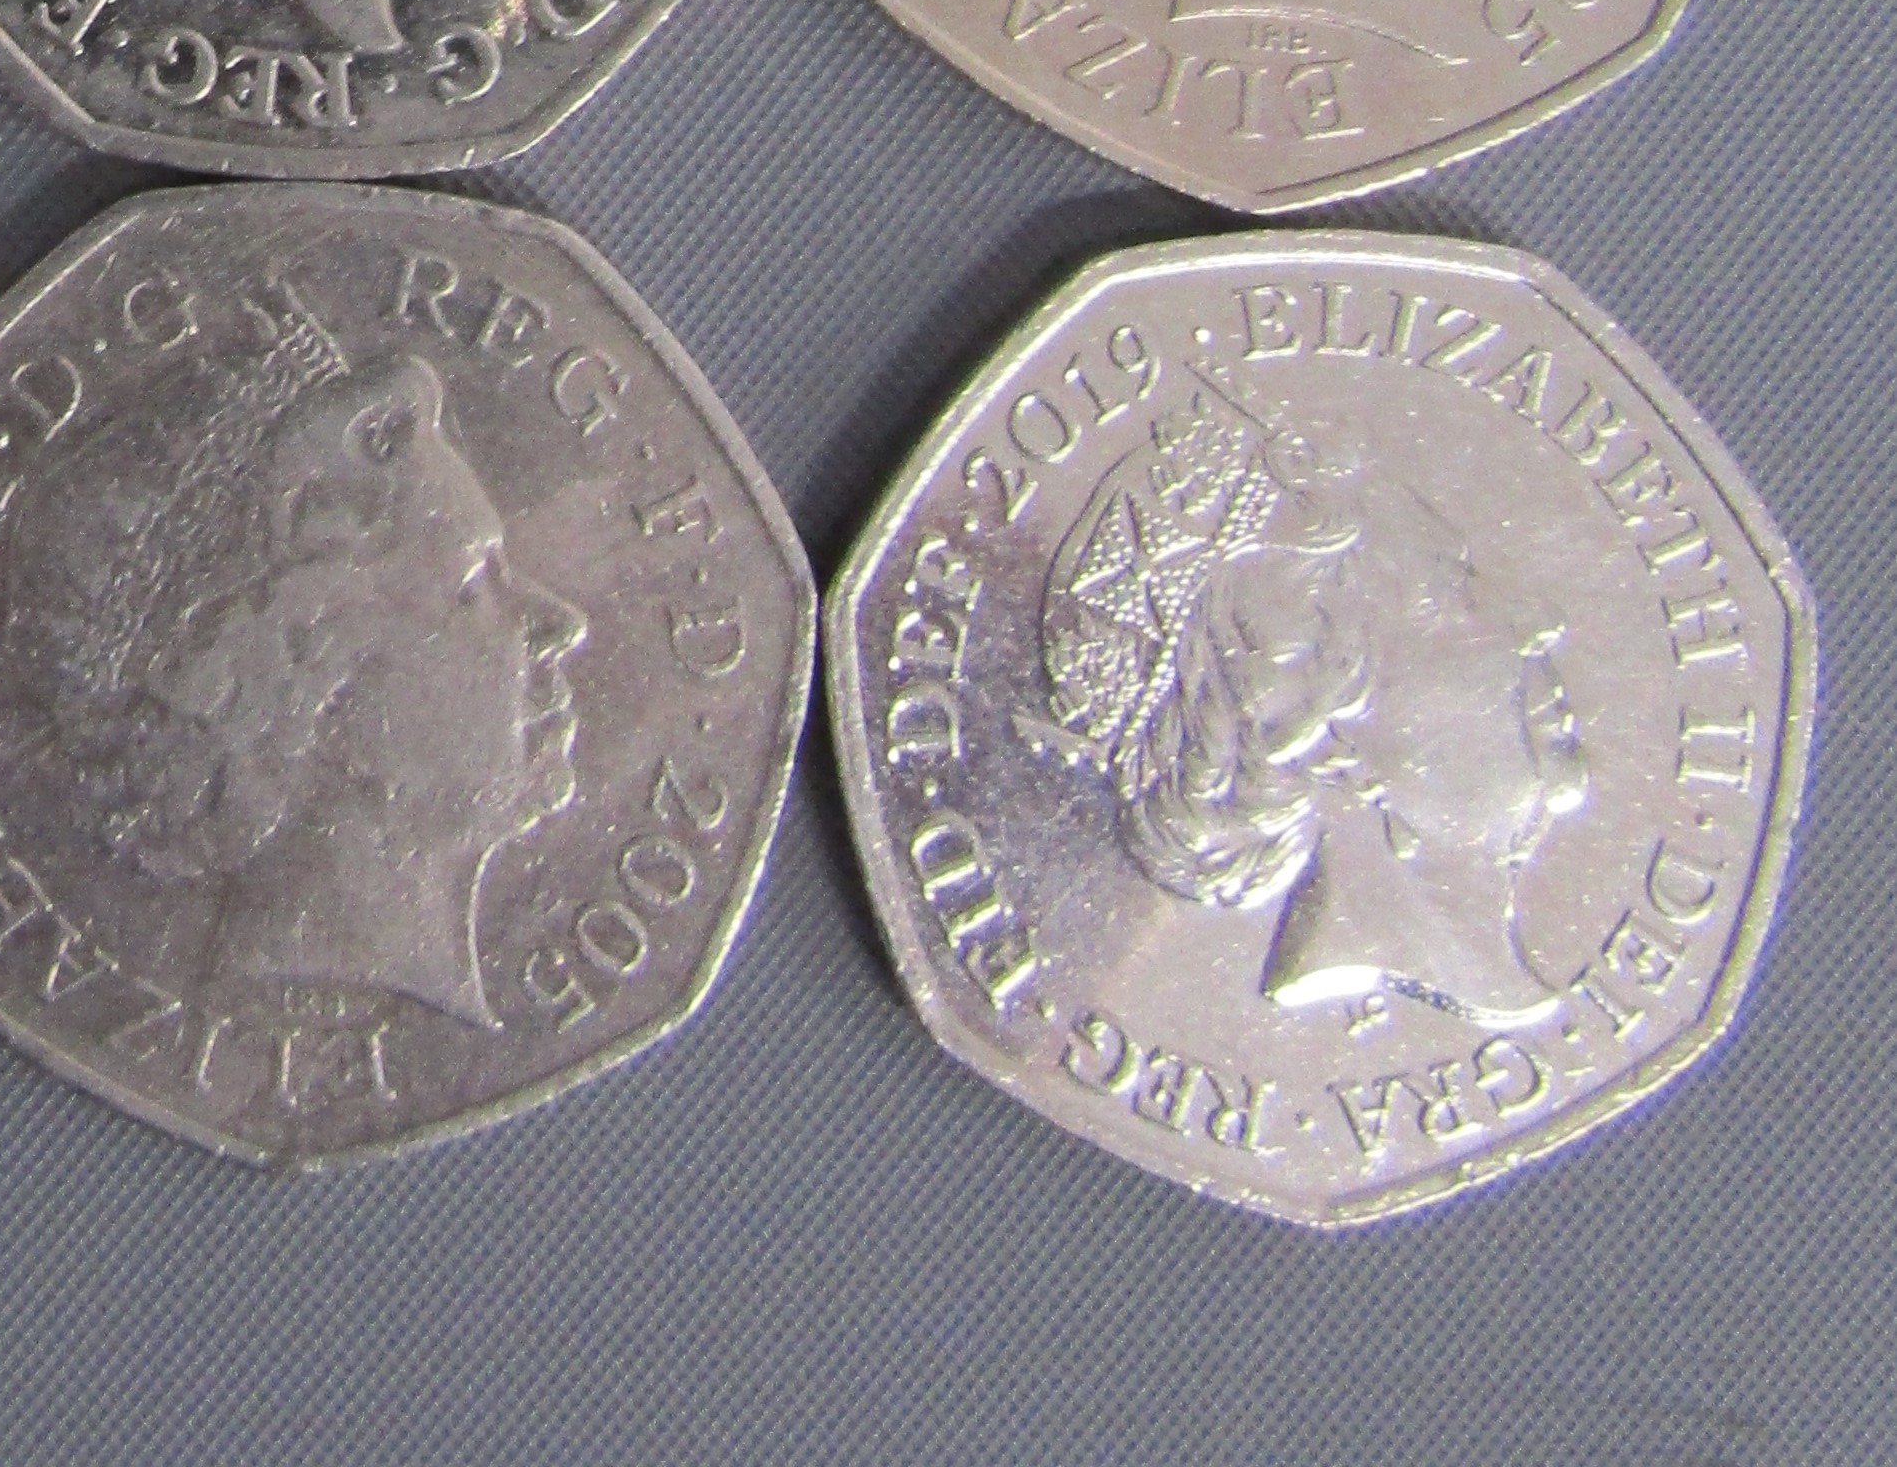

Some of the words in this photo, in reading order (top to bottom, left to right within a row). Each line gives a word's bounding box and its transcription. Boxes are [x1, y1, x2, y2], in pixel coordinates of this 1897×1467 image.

[143, 25, 360, 130] REG
[430, 21, 505, 106] G
[121, 265, 200, 351] G
[384, 254, 635, 439] REG
[8, 351, 85, 443] D
[963, 323, 1165, 525] 2019
[629, 473, 724, 546] F
[1230, 279, 1748, 668] ELIZABETH
[667, 601, 748, 678] D
[885, 533, 985, 767] DEF
[1676, 703, 1759, 794] II
[518, 754, 730, 1030] 2005
[911, 817, 1041, 1009] FID
[1569, 837, 1722, 1043] DEI
[1059, 1017, 1280, 1155] REG
[1330, 1036, 1557, 1175] GRA
